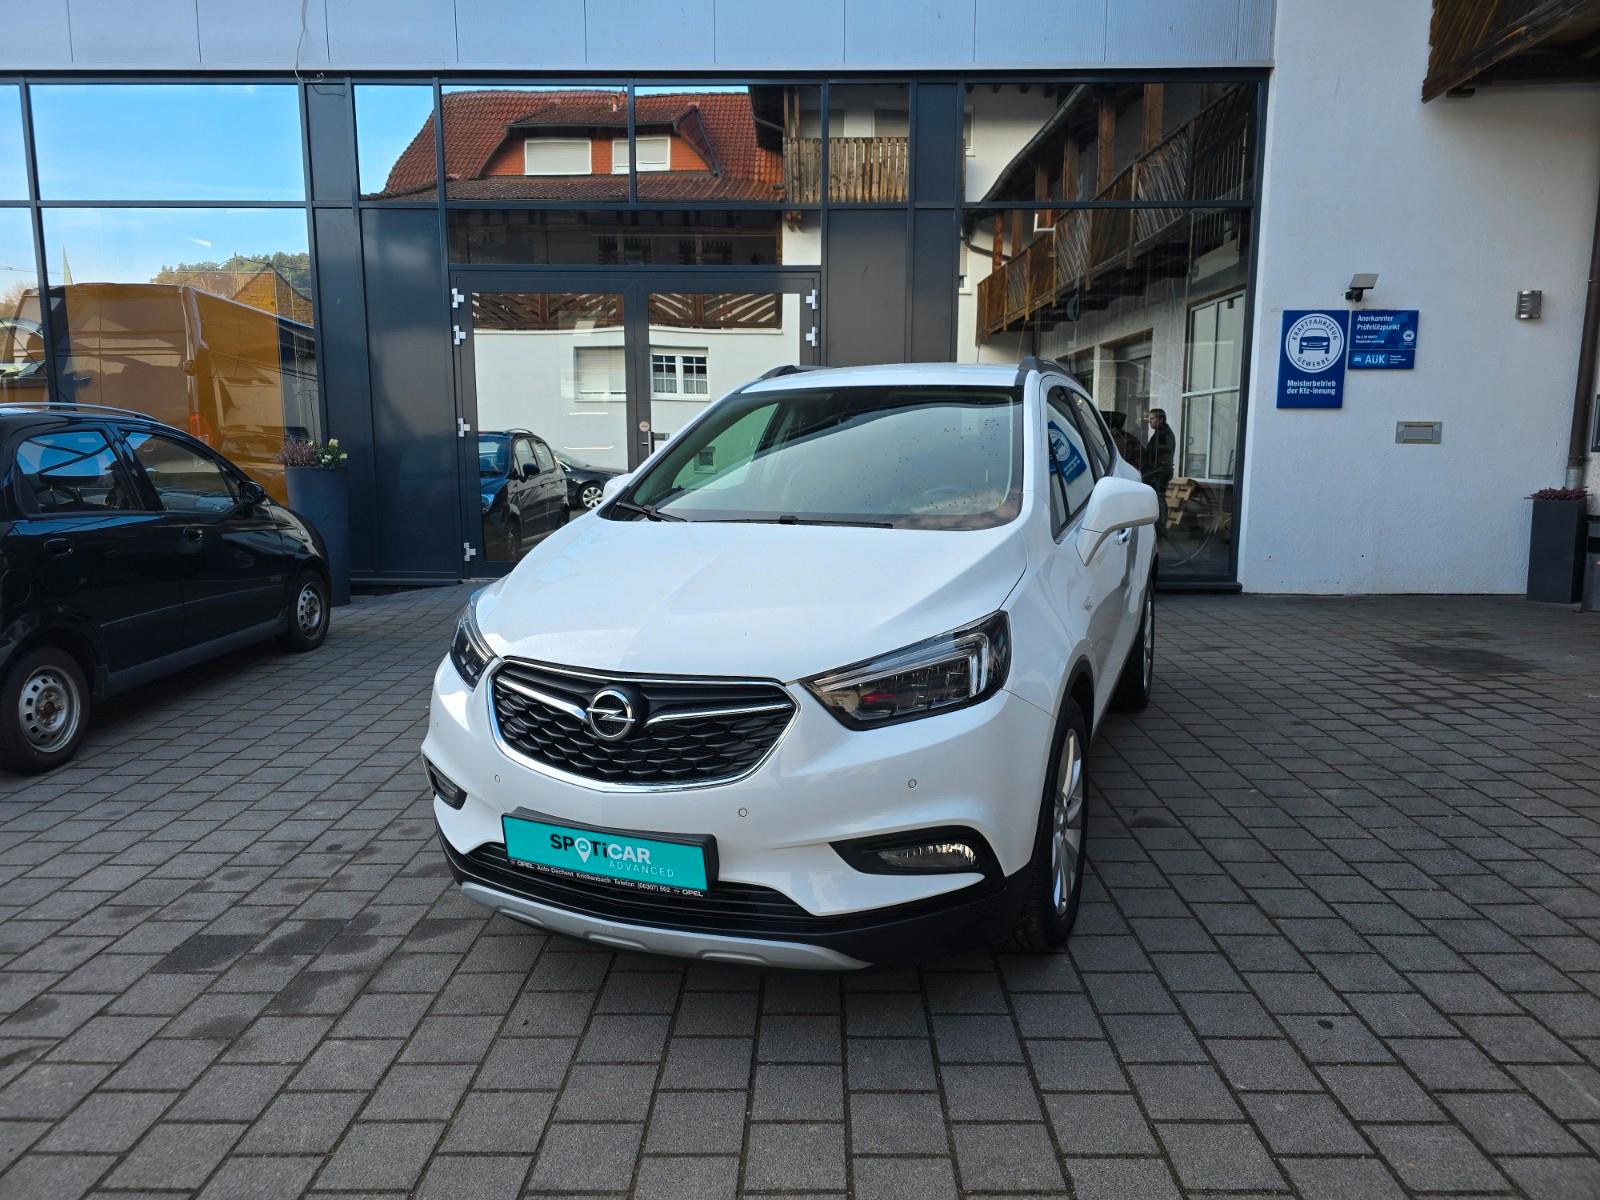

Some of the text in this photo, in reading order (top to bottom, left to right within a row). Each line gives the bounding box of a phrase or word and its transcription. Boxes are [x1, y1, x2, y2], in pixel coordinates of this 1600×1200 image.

[1291, 319, 1339, 341] KRAFTFAHRZEUG
[1357, 323, 1400, 331] Prüfstützpunkt
[1297, 356, 1330, 368] GEWERBE
[1299, 388, 1336, 396] Kfz-Innung
[609, 861, 674, 878] ADVANCED
[517, 860, 535, 870] OPEL
[536, 864, 550, 873] Auto
[682, 889, 704, 897] OPEL
